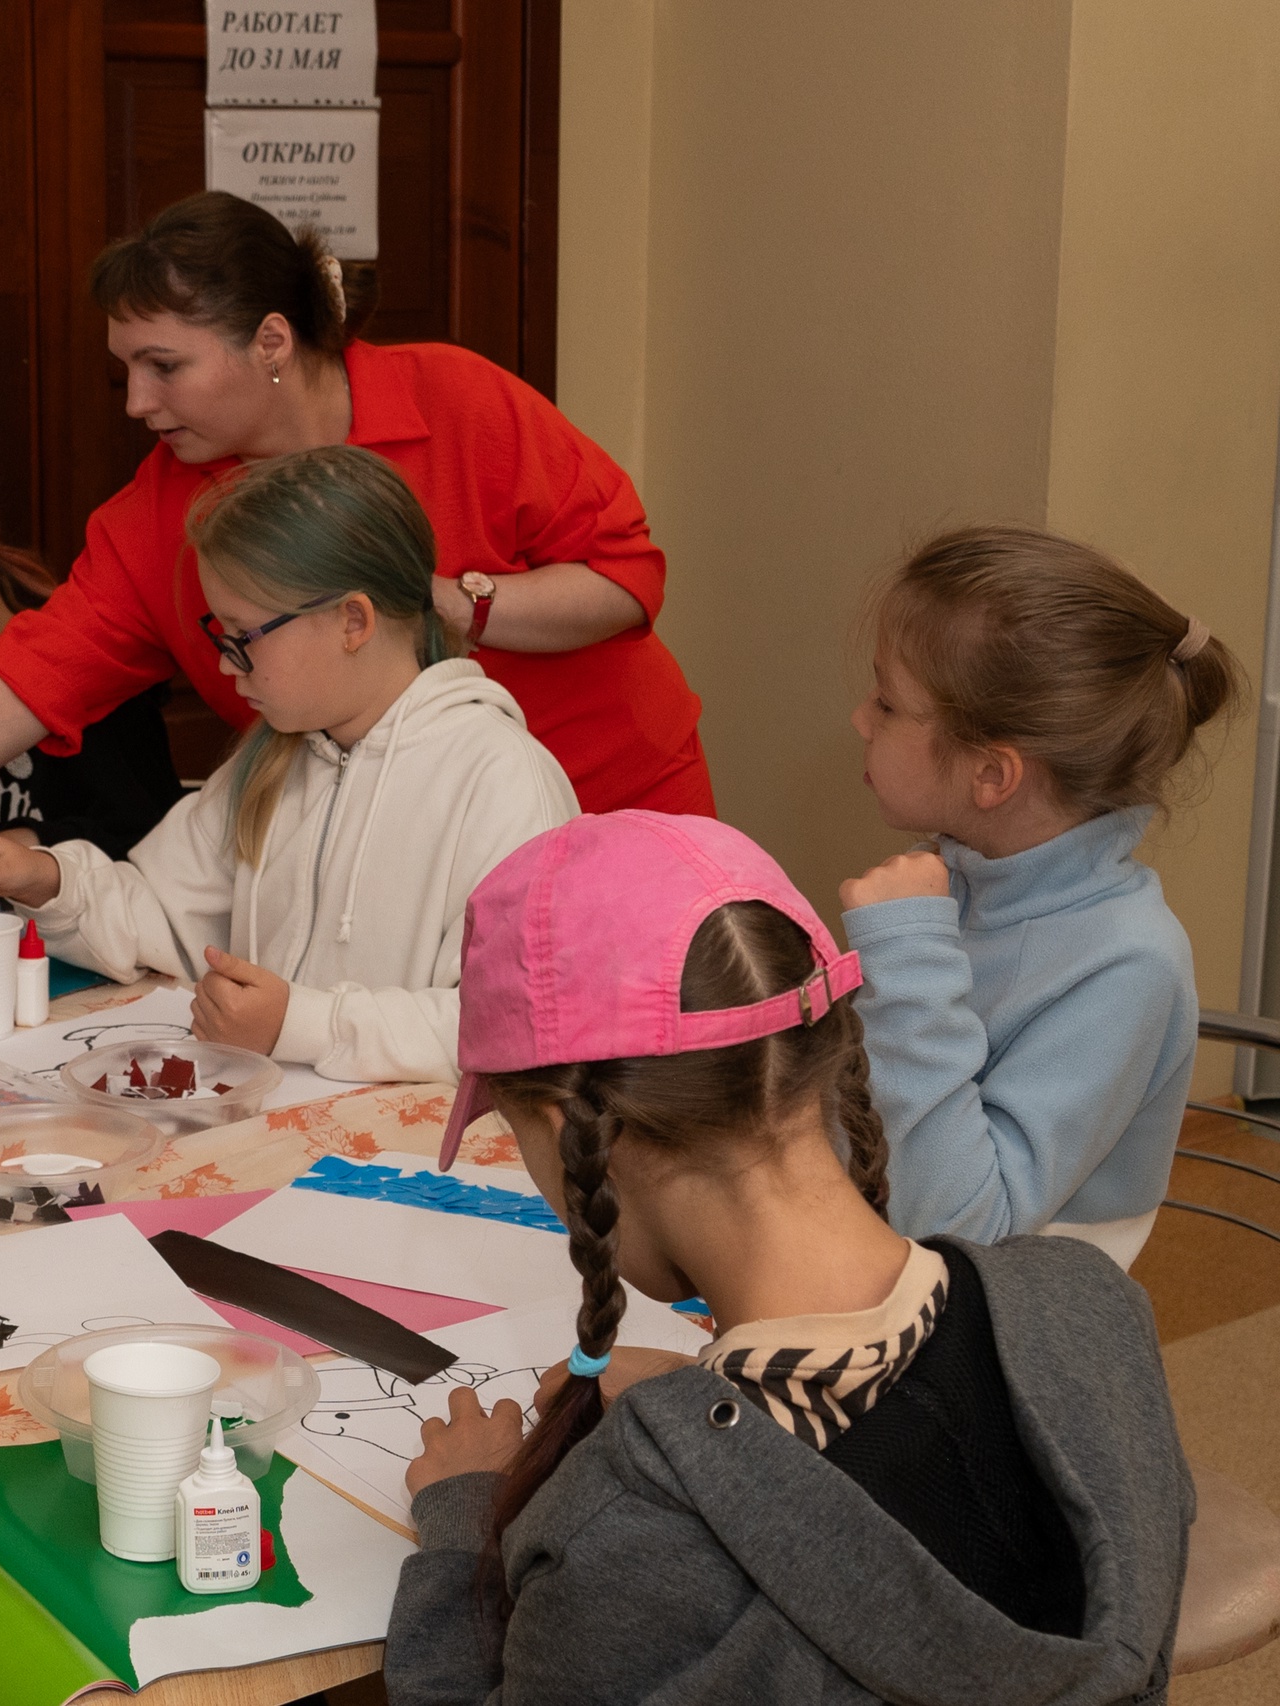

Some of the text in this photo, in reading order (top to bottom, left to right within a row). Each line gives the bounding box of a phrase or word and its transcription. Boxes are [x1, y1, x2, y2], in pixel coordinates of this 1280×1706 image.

[222, 11, 342, 34] РАБОТАЕТ
[220, 47, 341, 71] ДО 31 МАЯ
[242, 142, 355, 164] ОТКРЫТО
